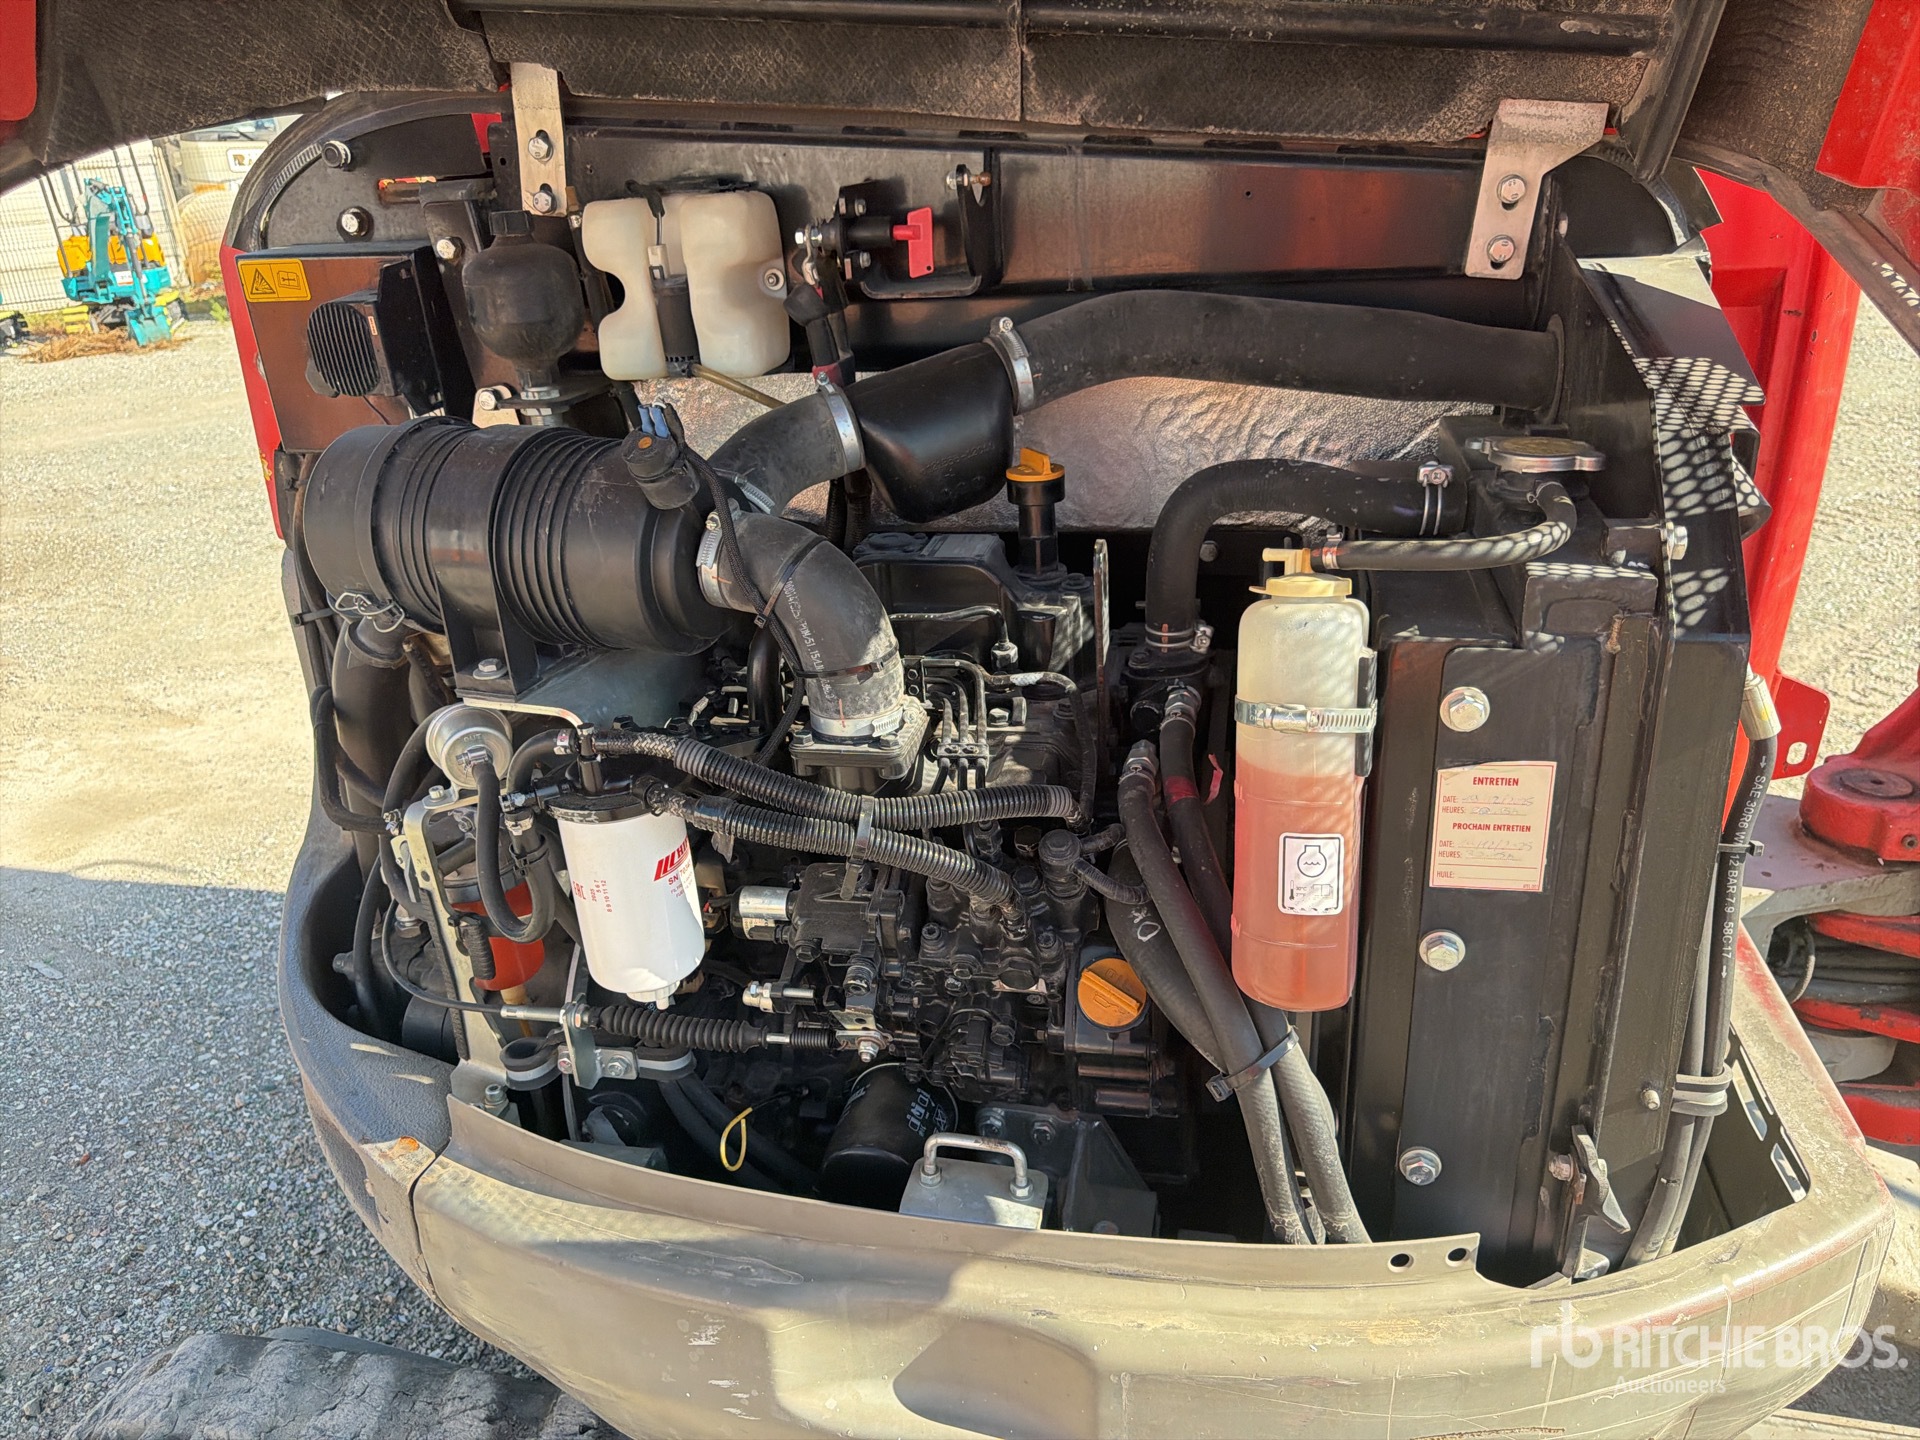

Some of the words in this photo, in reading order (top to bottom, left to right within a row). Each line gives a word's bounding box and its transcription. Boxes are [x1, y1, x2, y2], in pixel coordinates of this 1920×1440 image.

[463, 733, 482, 743] OUT
[1472, 776, 1520, 787] ENTRETIEN
[1749, 775, 1767, 799] SAE
[1442, 795, 1459, 803] DATE:
[1737, 800, 1758, 829] 30R6
[1452, 822, 1491, 831] PROCHAIN
[1492, 823, 1532, 833] ENTRETIEN
[1439, 839, 1455, 848] DATE:
[1438, 850, 1463, 859] HEURES:
[1728, 853, 1741, 867] 12
[668, 873, 680, 886] SN
[1436, 870, 1455, 879] HUILE:
[1725, 870, 1740, 894] BAR
[1721, 921, 1735, 959] 58C17
